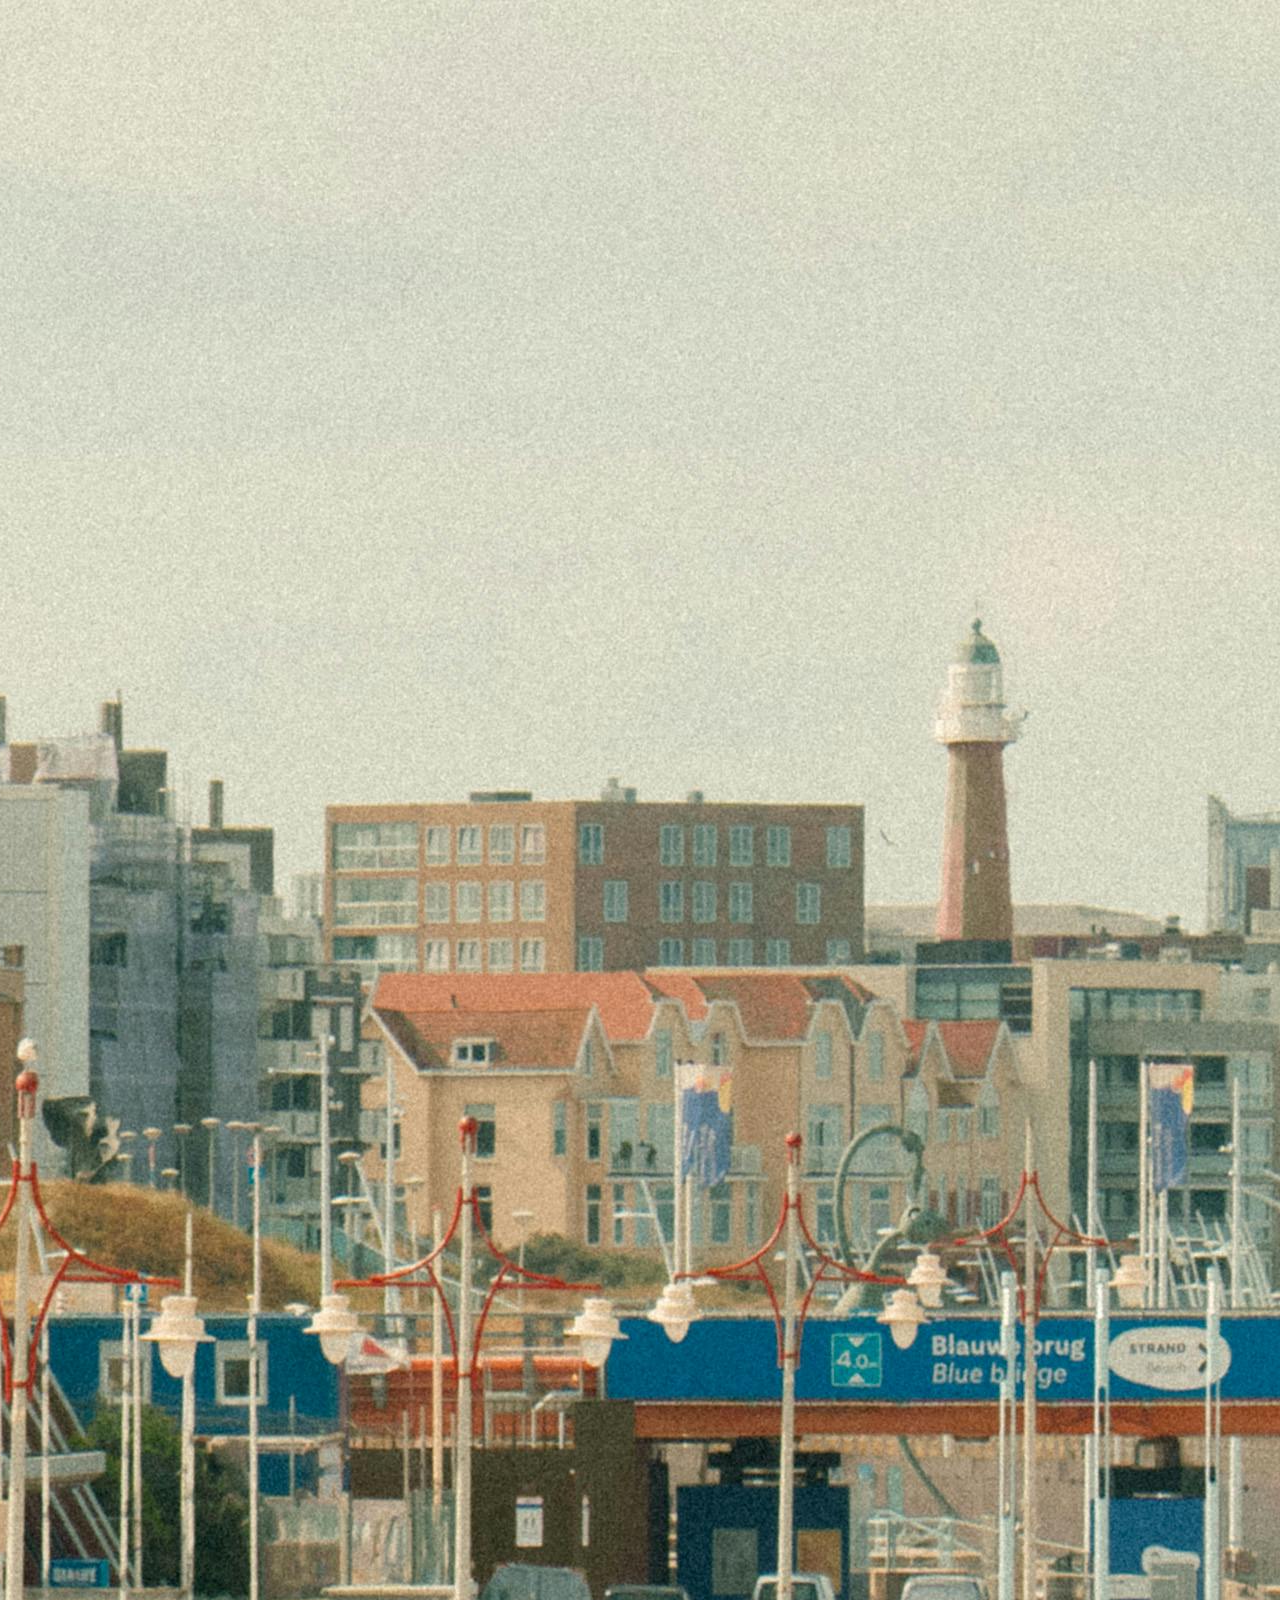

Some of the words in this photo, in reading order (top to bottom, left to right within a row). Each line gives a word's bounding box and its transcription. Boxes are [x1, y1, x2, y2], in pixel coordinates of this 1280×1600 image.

[1128, 1343, 1186, 1354] STRAND
[931, 1362, 983, 1384] Blue
[990, 1361, 1068, 1389] bige
